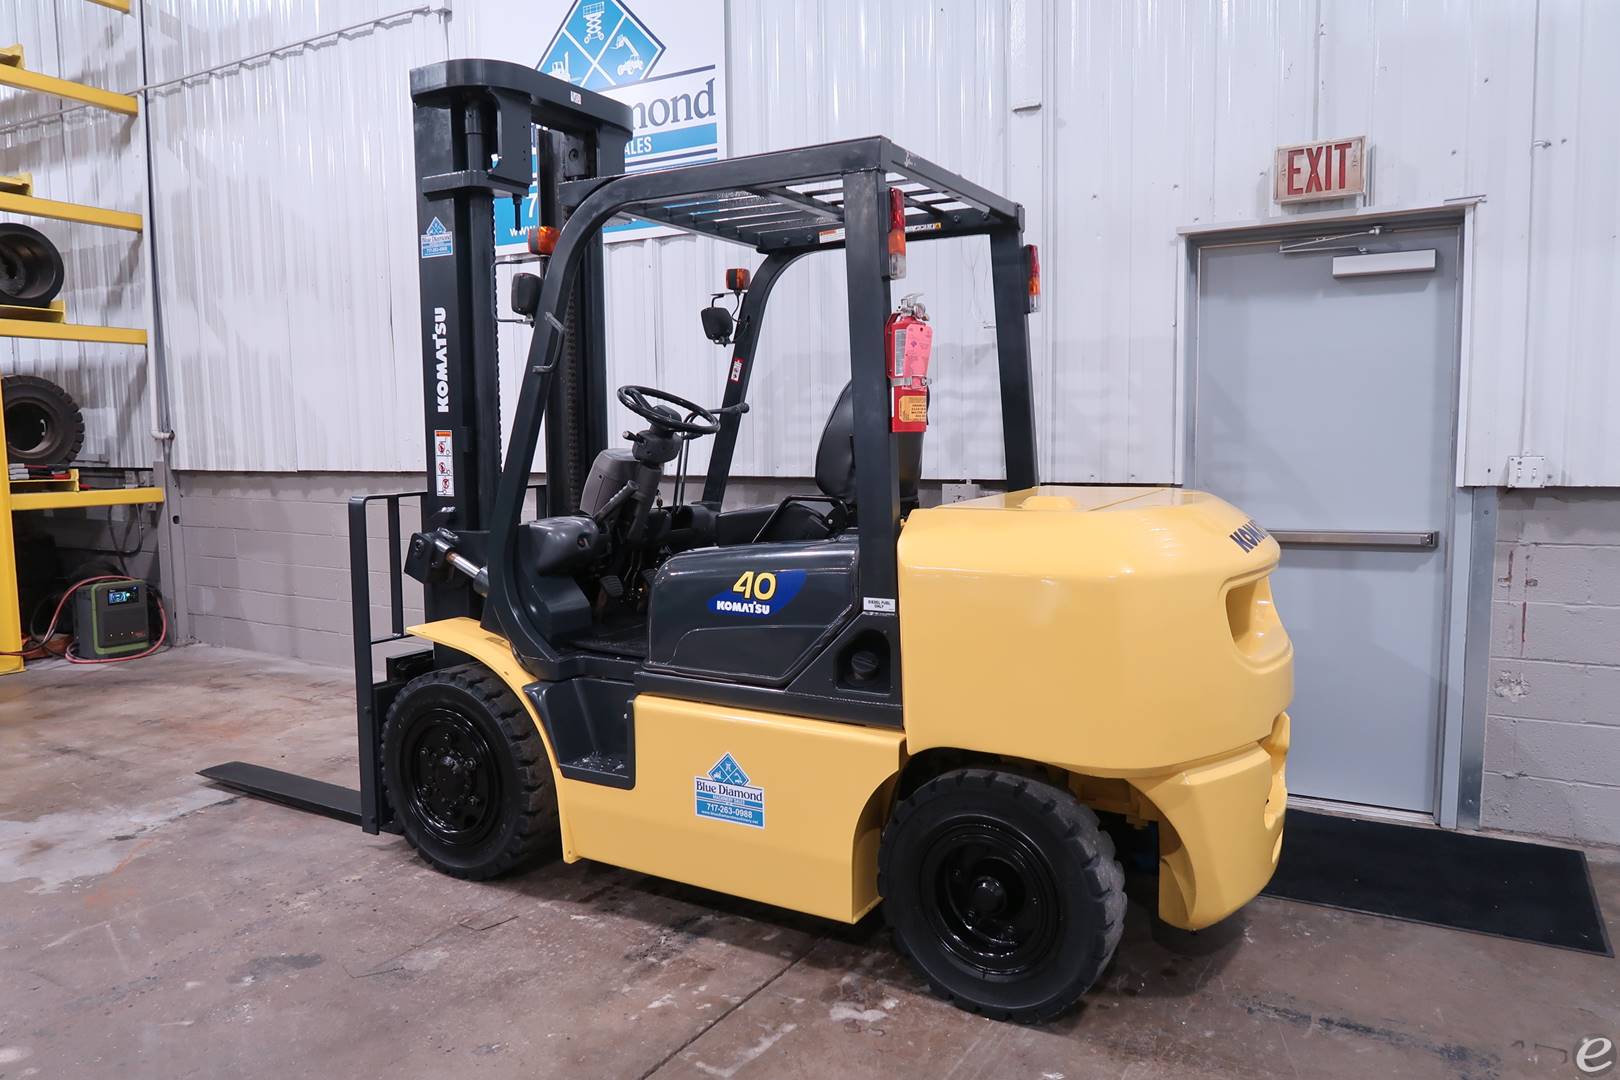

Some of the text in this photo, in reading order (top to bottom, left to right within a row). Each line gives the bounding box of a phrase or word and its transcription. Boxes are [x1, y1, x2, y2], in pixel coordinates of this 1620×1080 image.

[625, 136, 652, 156] ALES
[1287, 142, 1352, 195] EXIT
[432, 307, 449, 412] KOMATSU
[732, 571, 777, 600] 40
[716, 600, 770, 615] KOMATSU
[696, 781, 763, 802] Blue Diamond
[706, 803, 753, 819] 717-263-0988
